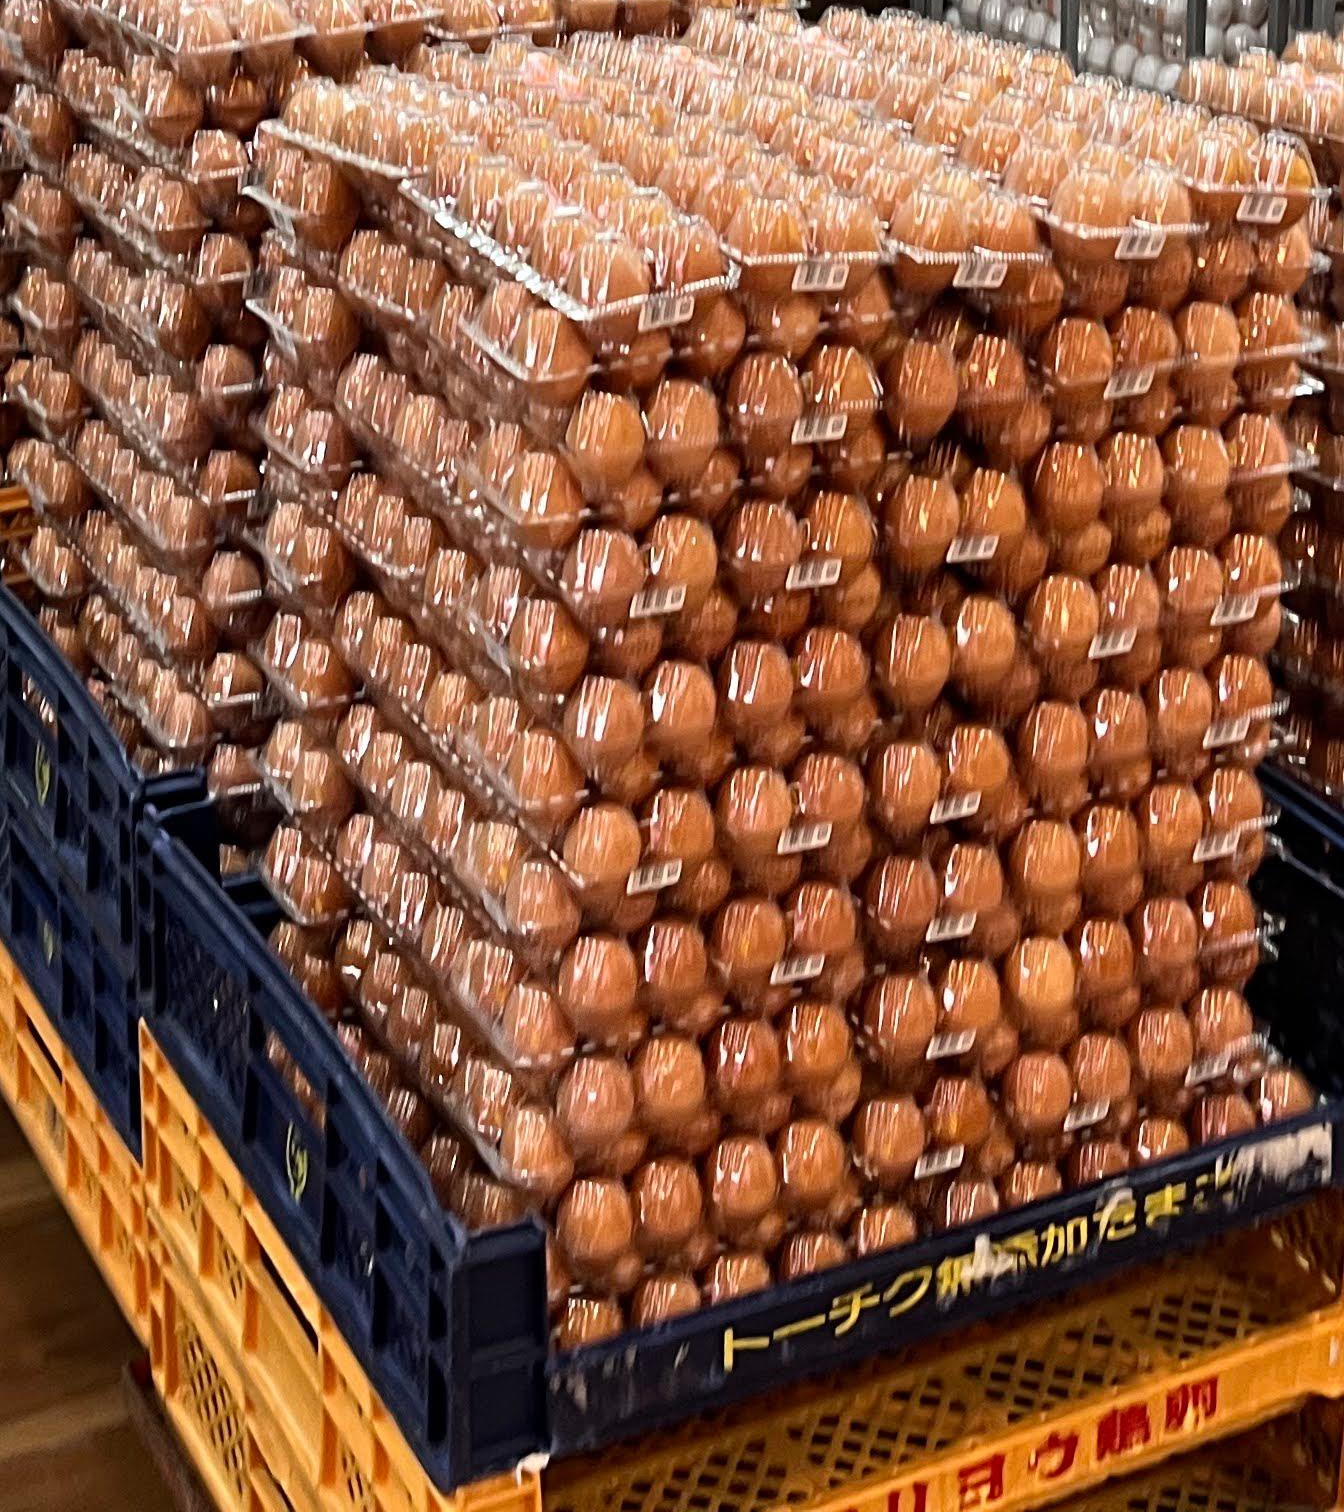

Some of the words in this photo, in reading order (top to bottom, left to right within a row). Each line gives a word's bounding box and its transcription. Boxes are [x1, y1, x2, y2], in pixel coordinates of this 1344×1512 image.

[848, 1376, 1219, 1512] リヨウ鶏卵
